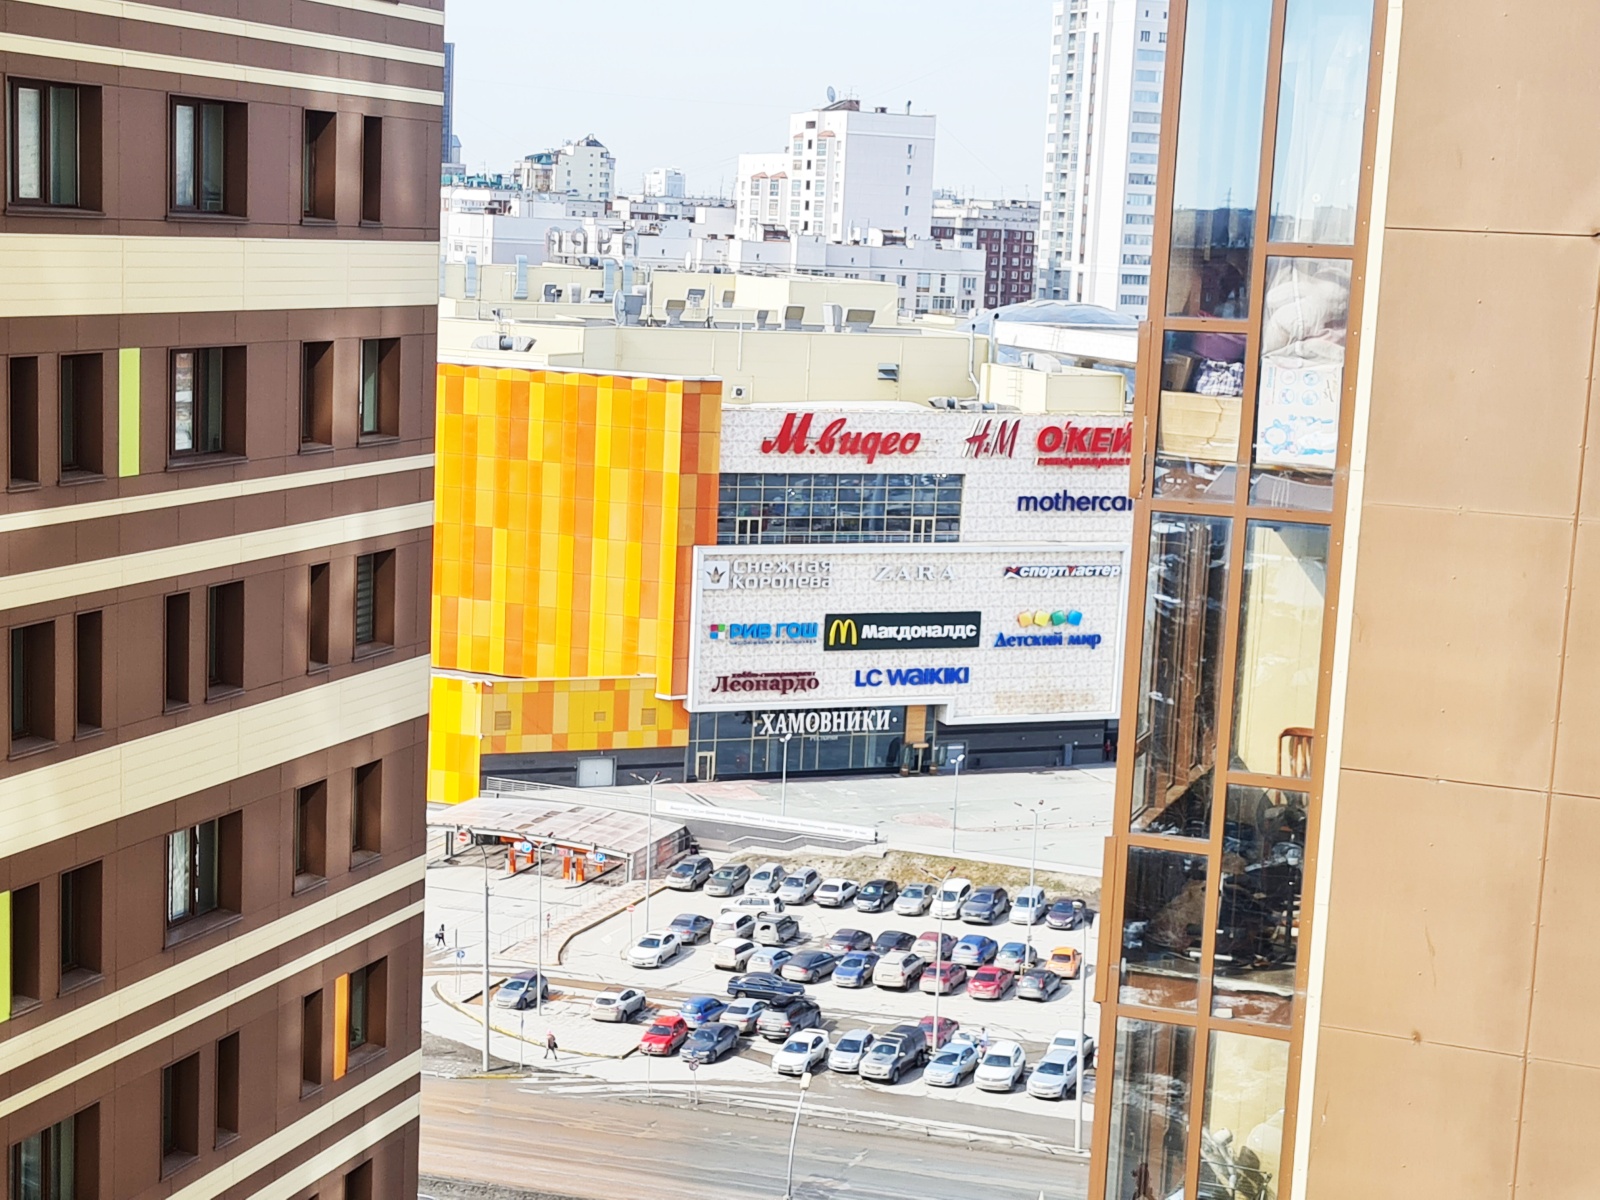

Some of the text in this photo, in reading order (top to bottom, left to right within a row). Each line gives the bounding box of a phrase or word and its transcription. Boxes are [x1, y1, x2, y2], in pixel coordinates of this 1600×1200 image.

[961, 417, 1022, 459] H&M
[874, 565, 956, 581] ZARA
[729, 622, 819, 640] РИВ ГОШ
[861, 624, 977, 641] Макдоналдс
[994, 632, 1102, 650] Детский мир
[711, 676, 820, 695] Леонардо
[855, 669, 882, 687] LC
[759, 709, 891, 735] ХАМОВНИКИ
